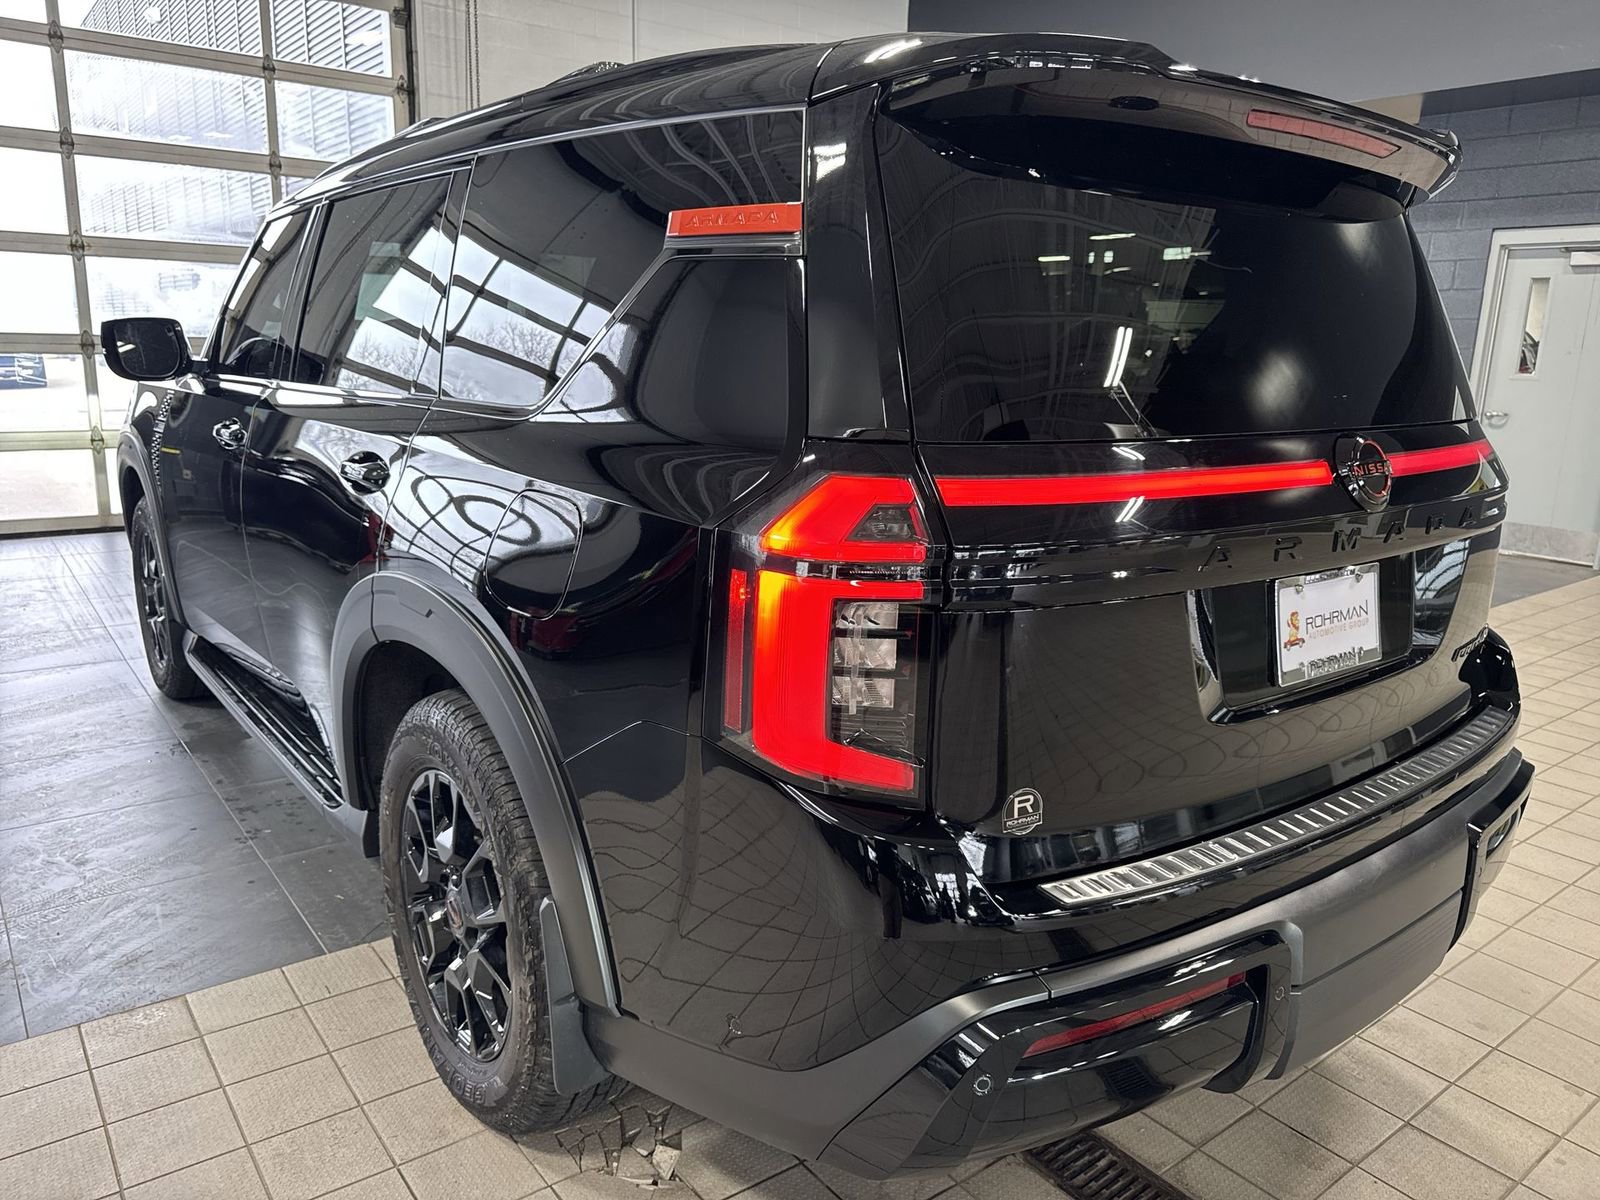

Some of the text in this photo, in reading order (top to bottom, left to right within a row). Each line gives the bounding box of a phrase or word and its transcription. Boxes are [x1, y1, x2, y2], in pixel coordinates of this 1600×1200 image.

[1353, 462, 1388, 477] NISS
[1197, 505, 1477, 571] ARMADA
[1305, 600, 1369, 635] ROHRMAN
[1308, 623, 1347, 640] AUTOMOTIVE
[1013, 795, 1034, 819] R
